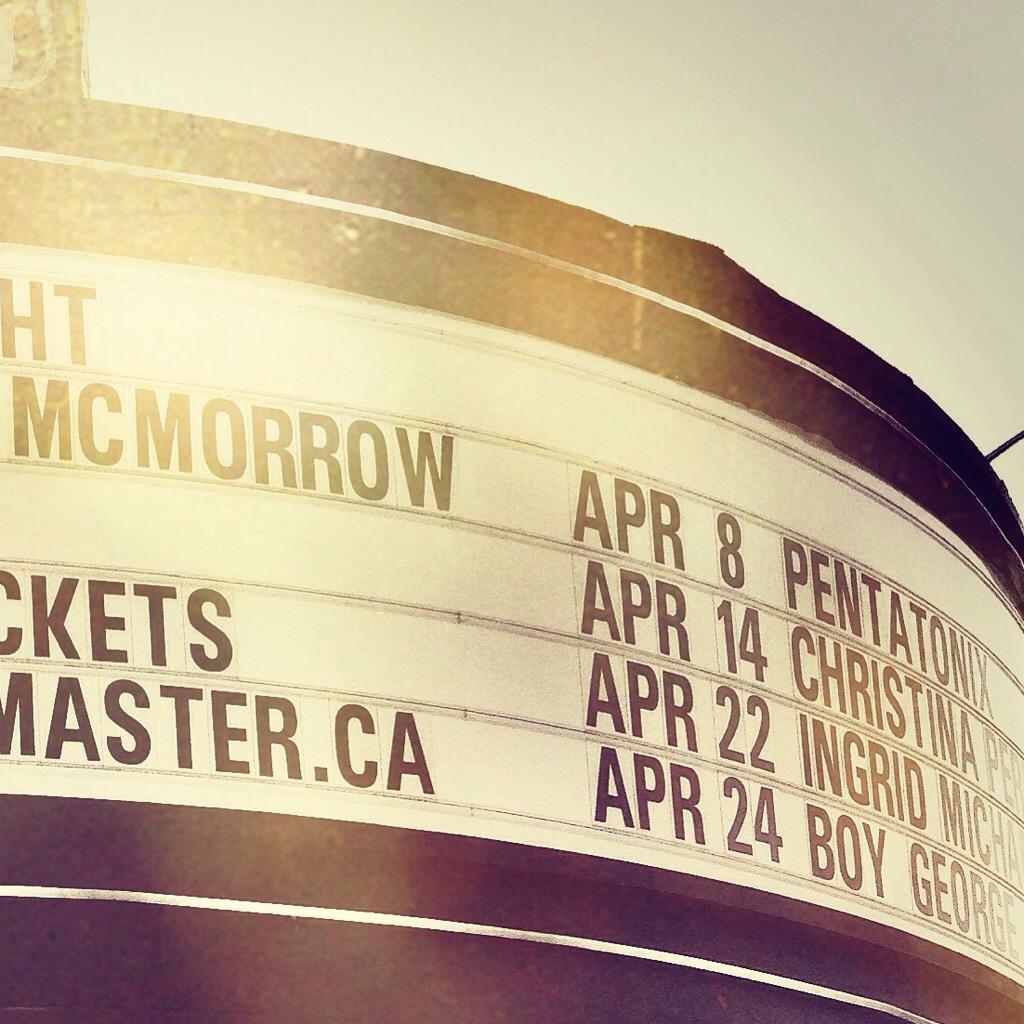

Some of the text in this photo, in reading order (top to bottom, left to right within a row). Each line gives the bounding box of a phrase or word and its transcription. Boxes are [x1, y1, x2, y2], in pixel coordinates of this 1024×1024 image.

[11, 375, 455, 512] MCMORROW
[573, 470, 994, 720] APR 8 PENTATONIX
[581, 561, 691, 662] APR
[717, 599, 768, 682] 14
[790, 627, 980, 783] CHRISTINA
[586, 653, 699, 753] APR
[716, 686, 776, 774] 22
[798, 713, 928, 831] INGRID
[595, 747, 1019, 962] APR 24 BOY GEORGE
